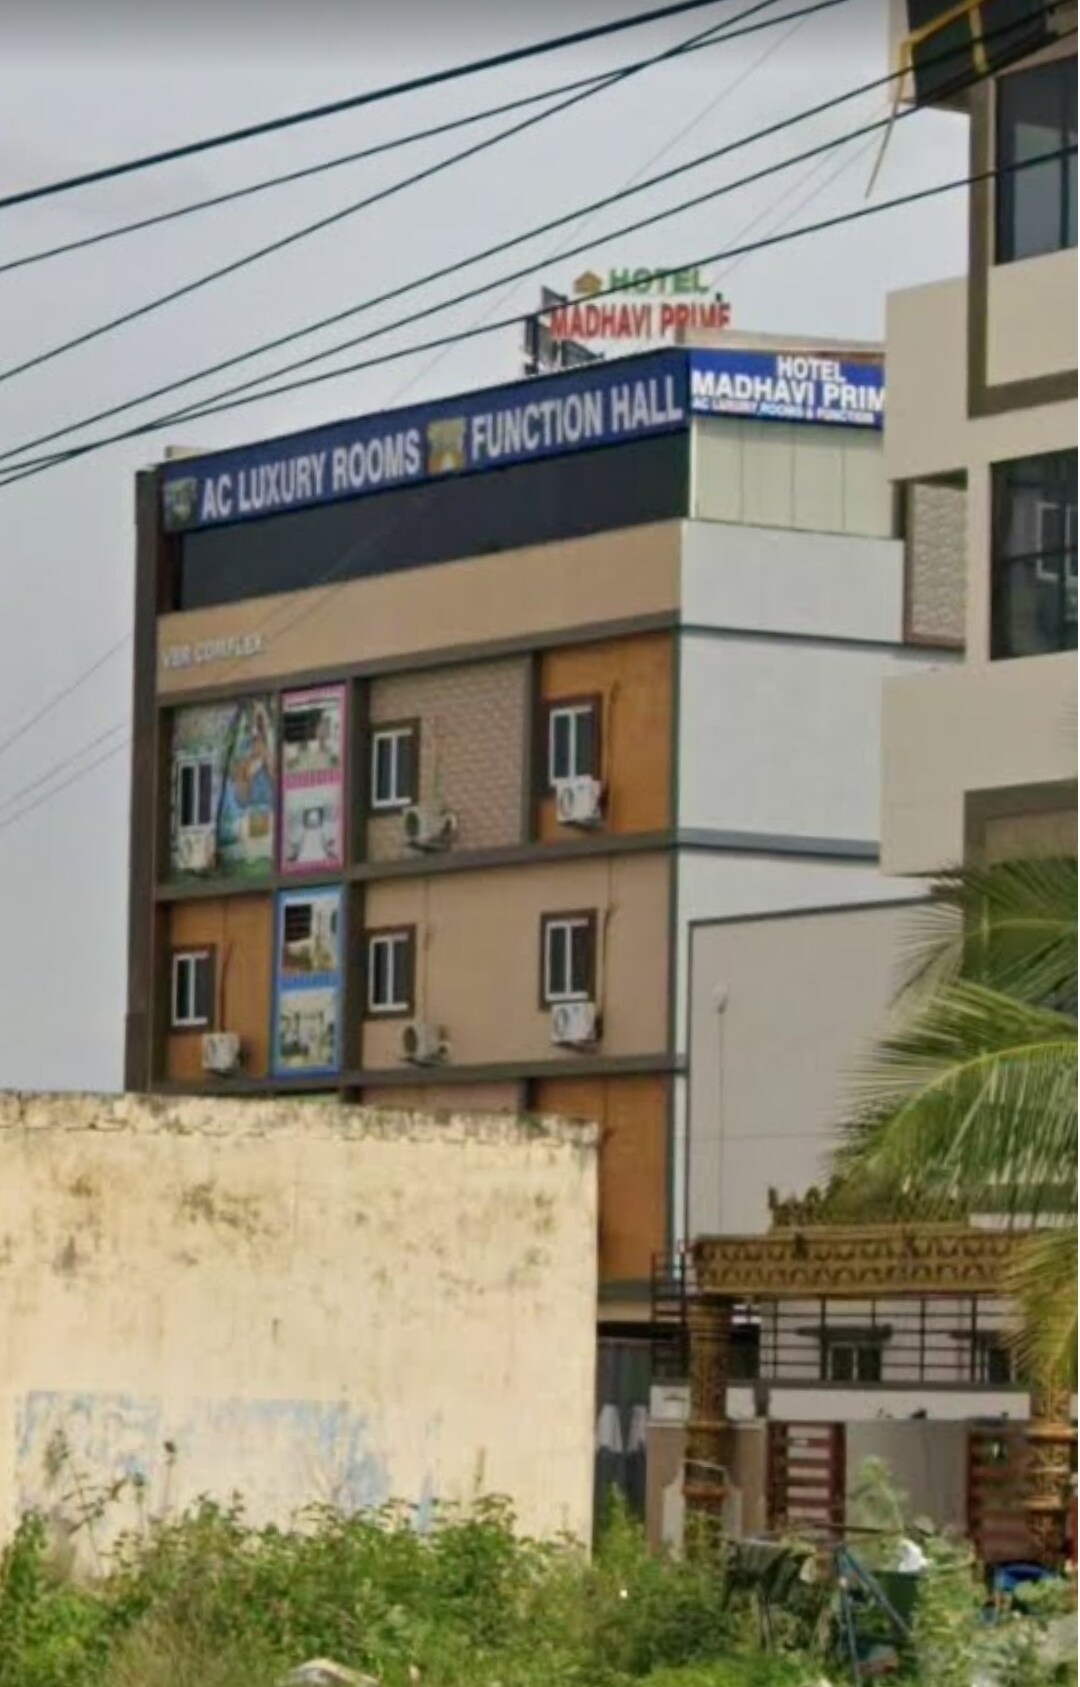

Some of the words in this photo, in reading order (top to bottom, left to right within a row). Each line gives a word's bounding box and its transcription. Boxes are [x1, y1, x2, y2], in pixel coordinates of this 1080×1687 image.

[610, 269, 709, 295] HOTEL
[551, 303, 653, 339] MADHAVI
[776, 356, 846, 382] HOTEL
[691, 370, 814, 404] MADHAVI
[202, 474, 232, 520] AC
[238, 452, 326, 513] LUXURY
[332, 430, 420, 492] ROOMS
[471, 391, 603, 461] FUNCTION
[611, 375, 683, 433] HALL
